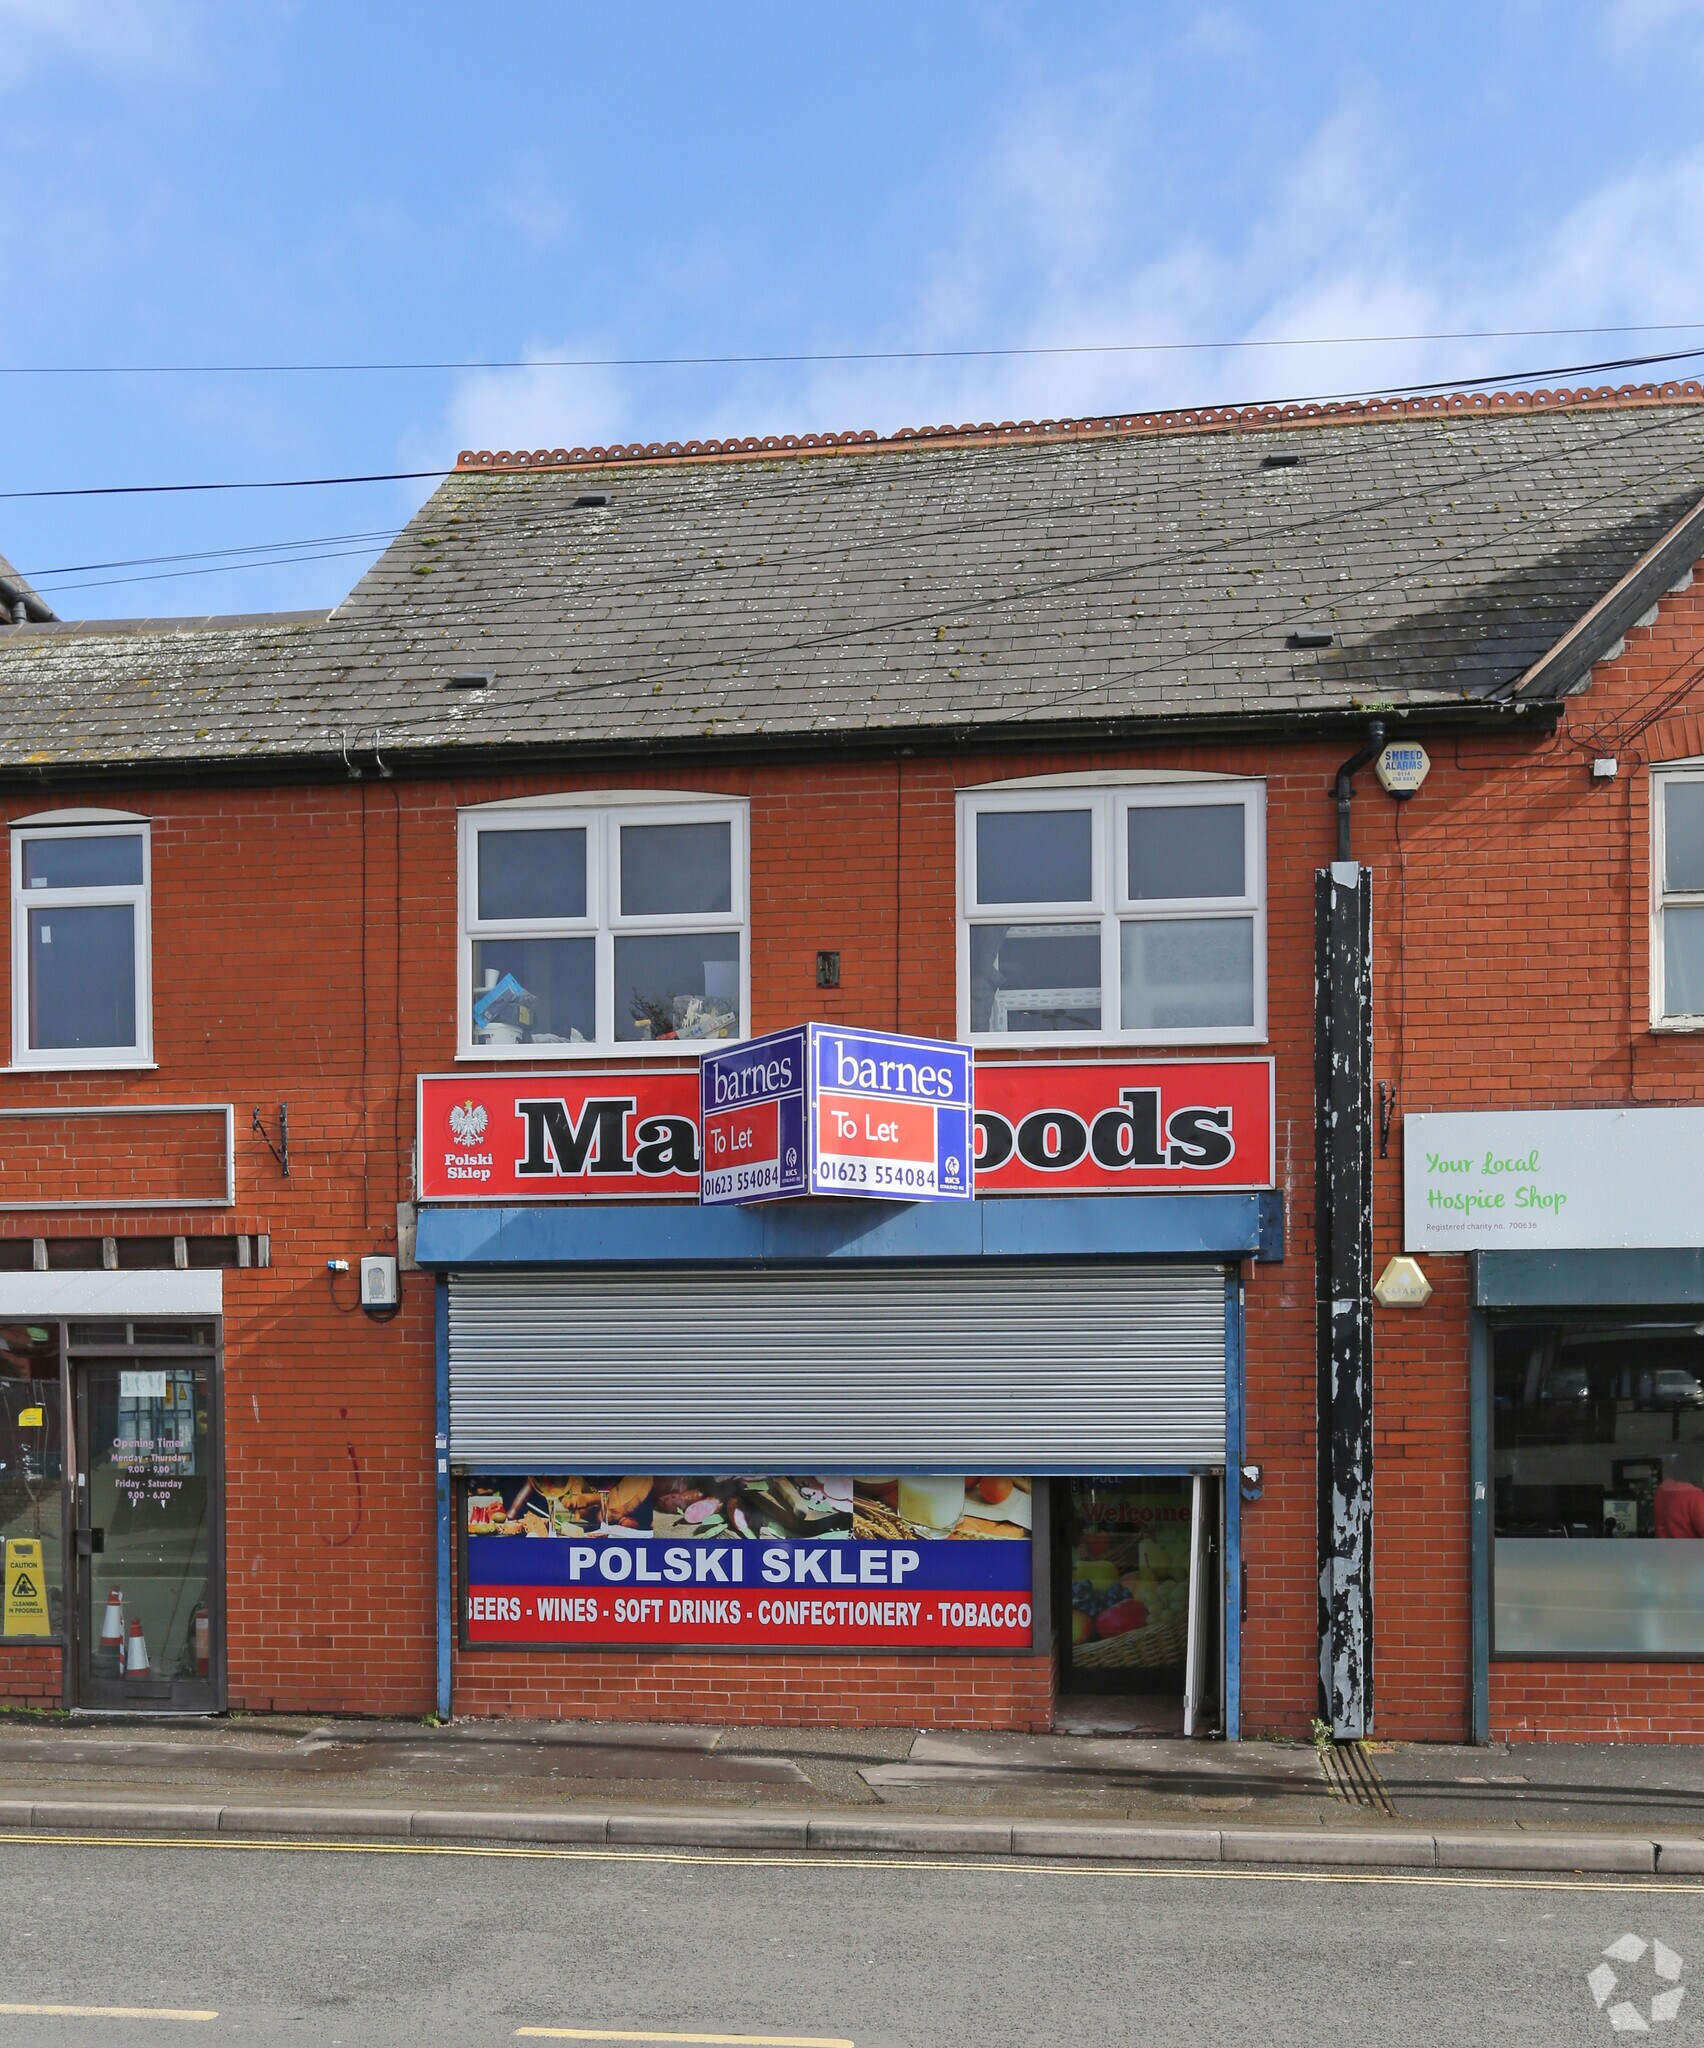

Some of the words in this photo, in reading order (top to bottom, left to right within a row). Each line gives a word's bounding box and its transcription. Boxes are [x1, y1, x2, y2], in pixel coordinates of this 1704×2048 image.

[1385, 750, 1423, 760] SHIELD
[1385, 761, 1423, 770] ALARMS
[713, 1057, 793, 1104] barnes
[833, 1041, 954, 1098] barnes
[515, 1096, 700, 1178] Ma
[974, 1086, 1236, 1173] oods
[831, 1110, 858, 1139] To
[865, 1114, 899, 1143] Let
[711, 1128, 727, 1154] To
[731, 1125, 753, 1151] Let
[444, 1153, 494, 1166] Polski
[1426, 1153, 1474, 1173] Your
[1481, 1149, 1541, 1175] Local
[446, 1167, 491, 1182] Sklep
[704, 1174, 733, 1196] 01623
[737, 1166, 779, 1191] 554084
[820, 1161, 867, 1182] 01623
[875, 1165, 936, 1188] 554084
[1427, 1189, 1505, 1216] Hospice
[1514, 1185, 1567, 1215] Shop
[1426, 1223, 1465, 1232] Registered
[1467, 1223, 1492, 1231] charity
[1508, 1221, 1537, 1230] 700636
[113, 1437, 154, 1449] Opening
[111, 1453, 143, 1463] Monday
[151, 1453, 187, 1463] Thursday
[128, 1465, 145, 1473] 9.00
[153, 1465, 170, 1473] 9.00
[115, 1479, 140, 1489] Friday
[147, 1479, 183, 1490] Saturday
[128, 1491, 145, 1499] 9.00
[152, 1491, 171, 1499] 6.00
[1083, 1502, 1191, 1522] Welcome
[569, 1547, 744, 1582] POLSKI
[761, 1548, 920, 1584] SKLEP
[537, 1598, 598, 1622] WINES
[614, 1599, 663, 1624] SOFT
[669, 1599, 741, 1625] DRINKS
[757, 1600, 922, 1626] CONFECTIONERY
[938, 1602, 1032, 1627] TOBACCO
